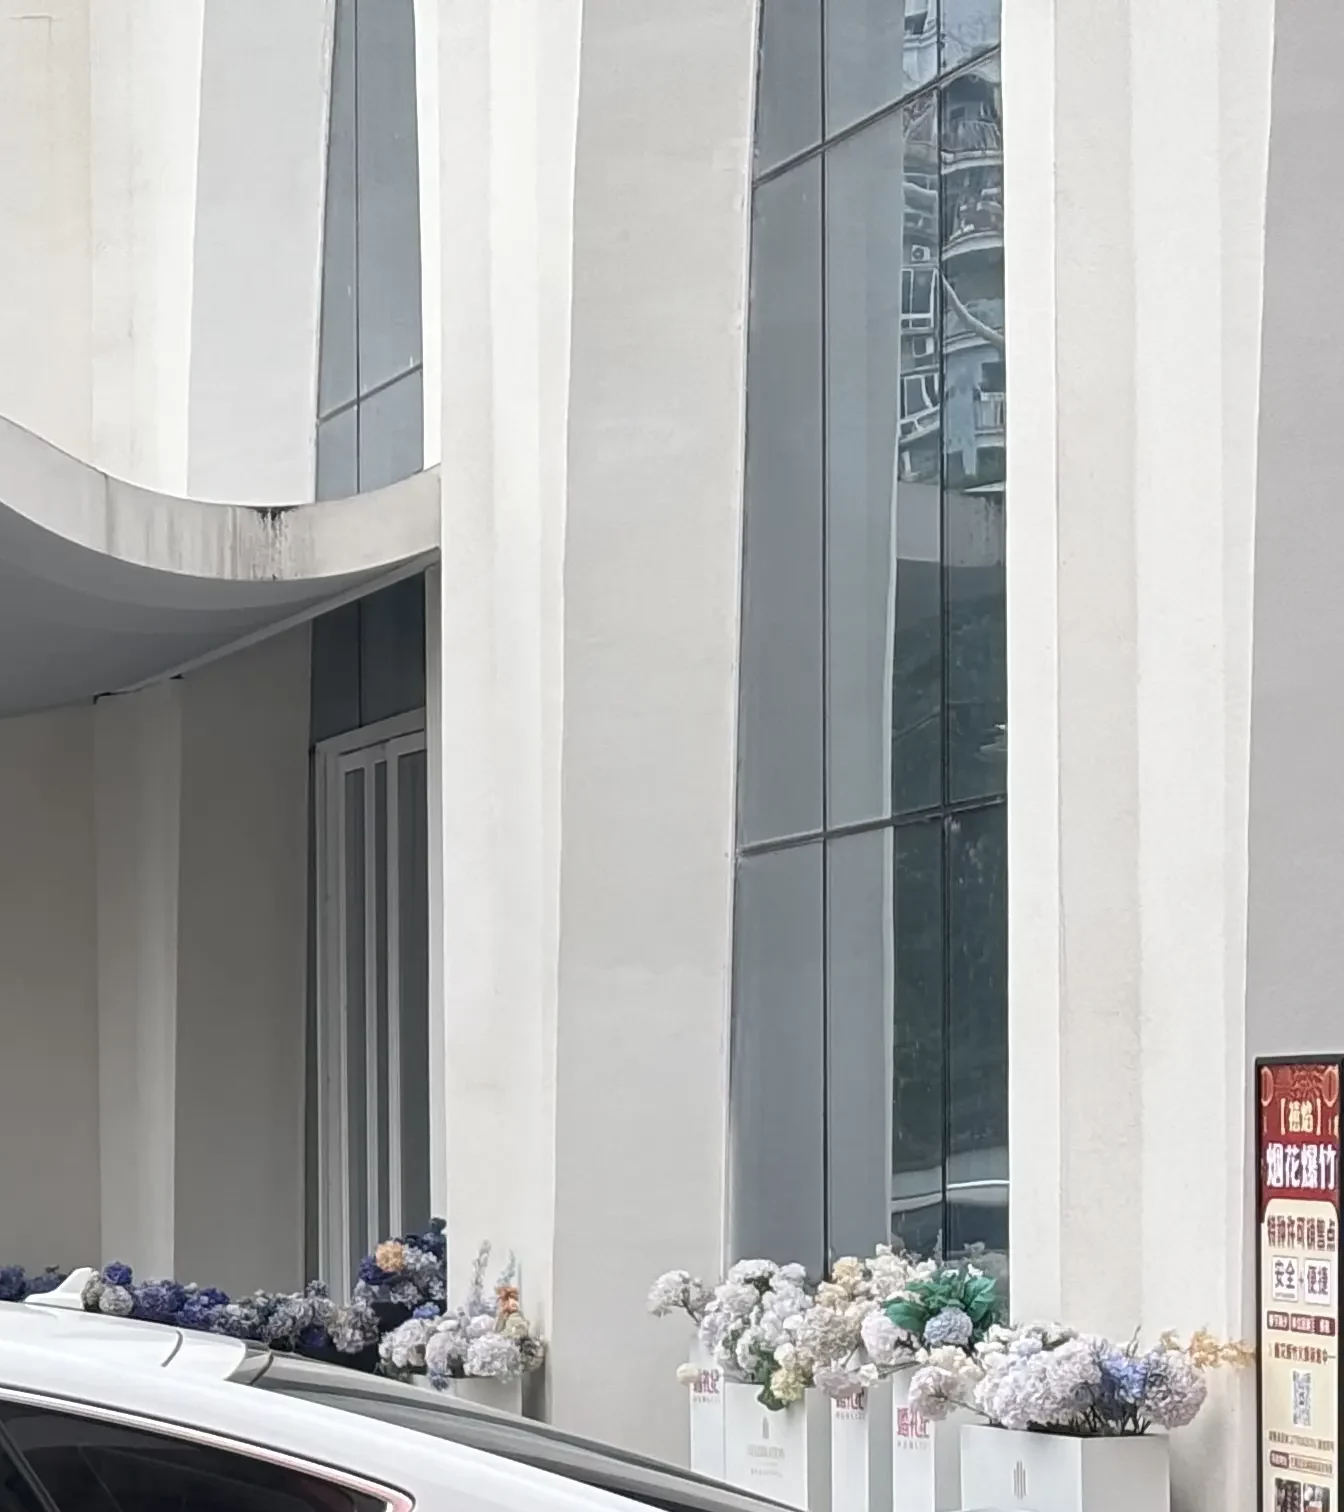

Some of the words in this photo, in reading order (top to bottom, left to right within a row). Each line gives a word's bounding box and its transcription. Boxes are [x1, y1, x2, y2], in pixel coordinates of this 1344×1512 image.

[1266, 1142, 1337, 1190] 烟花爆竹
[1274, 1259, 1295, 1290] 安全
